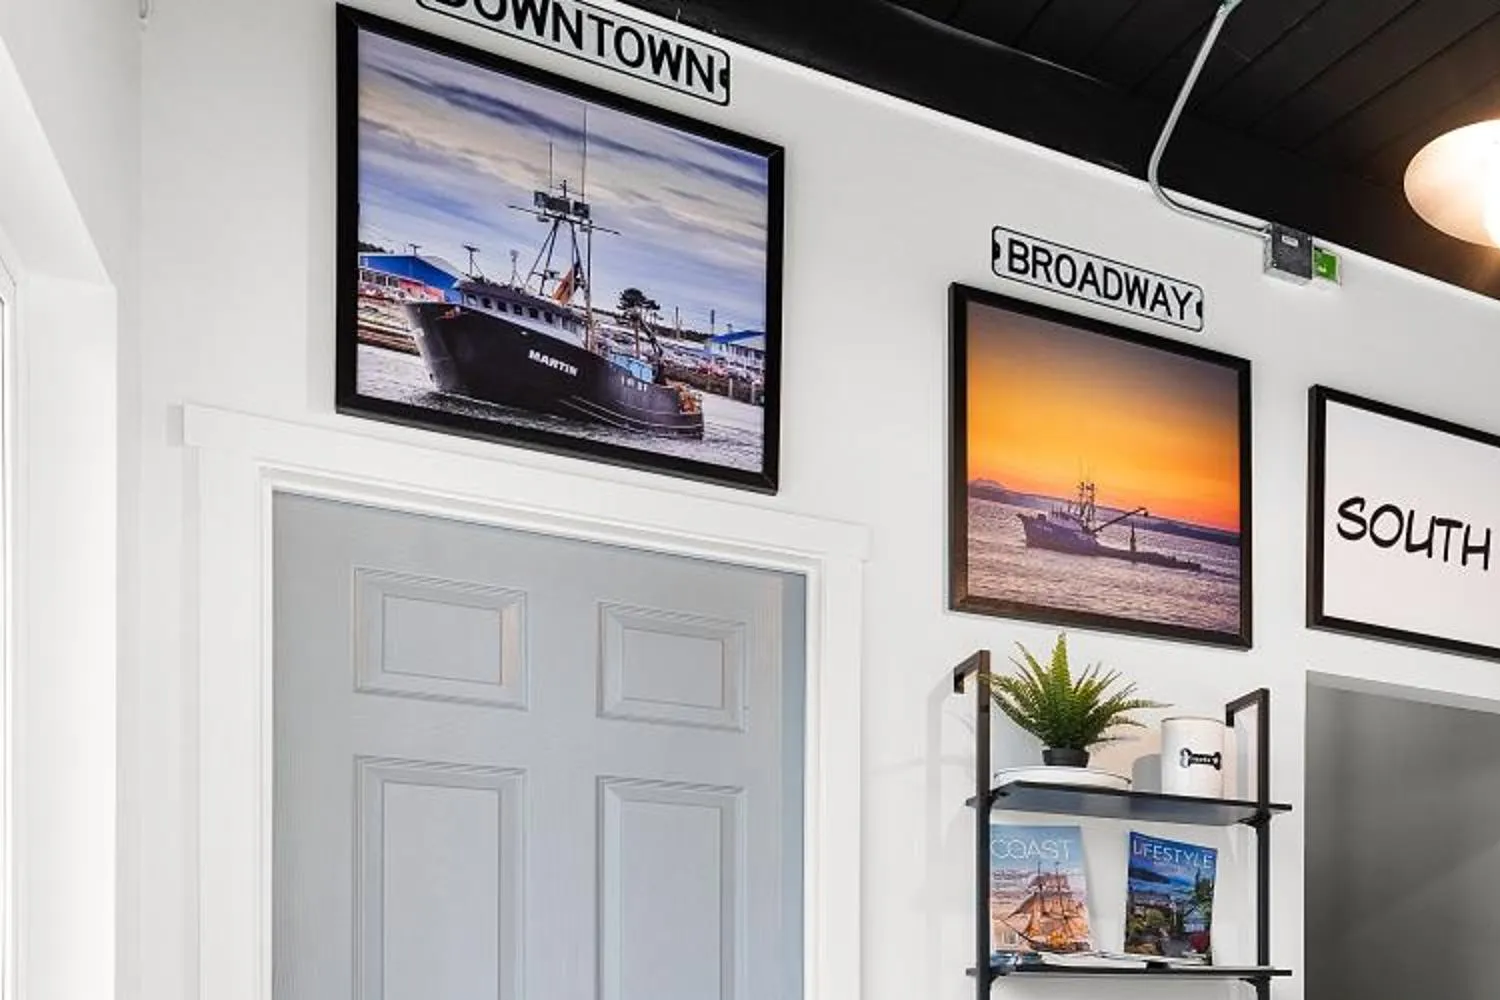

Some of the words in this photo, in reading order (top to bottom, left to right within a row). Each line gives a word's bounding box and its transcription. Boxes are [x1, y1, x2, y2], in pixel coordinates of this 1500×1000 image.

[434, 0, 715, 94] OWNTOWN
[1006, 238, 1194, 322] BROADWAY
[528, 349, 579, 377] MARTIN
[1336, 496, 1491, 571] SOUTH
[991, 838, 1075, 860] COAST
